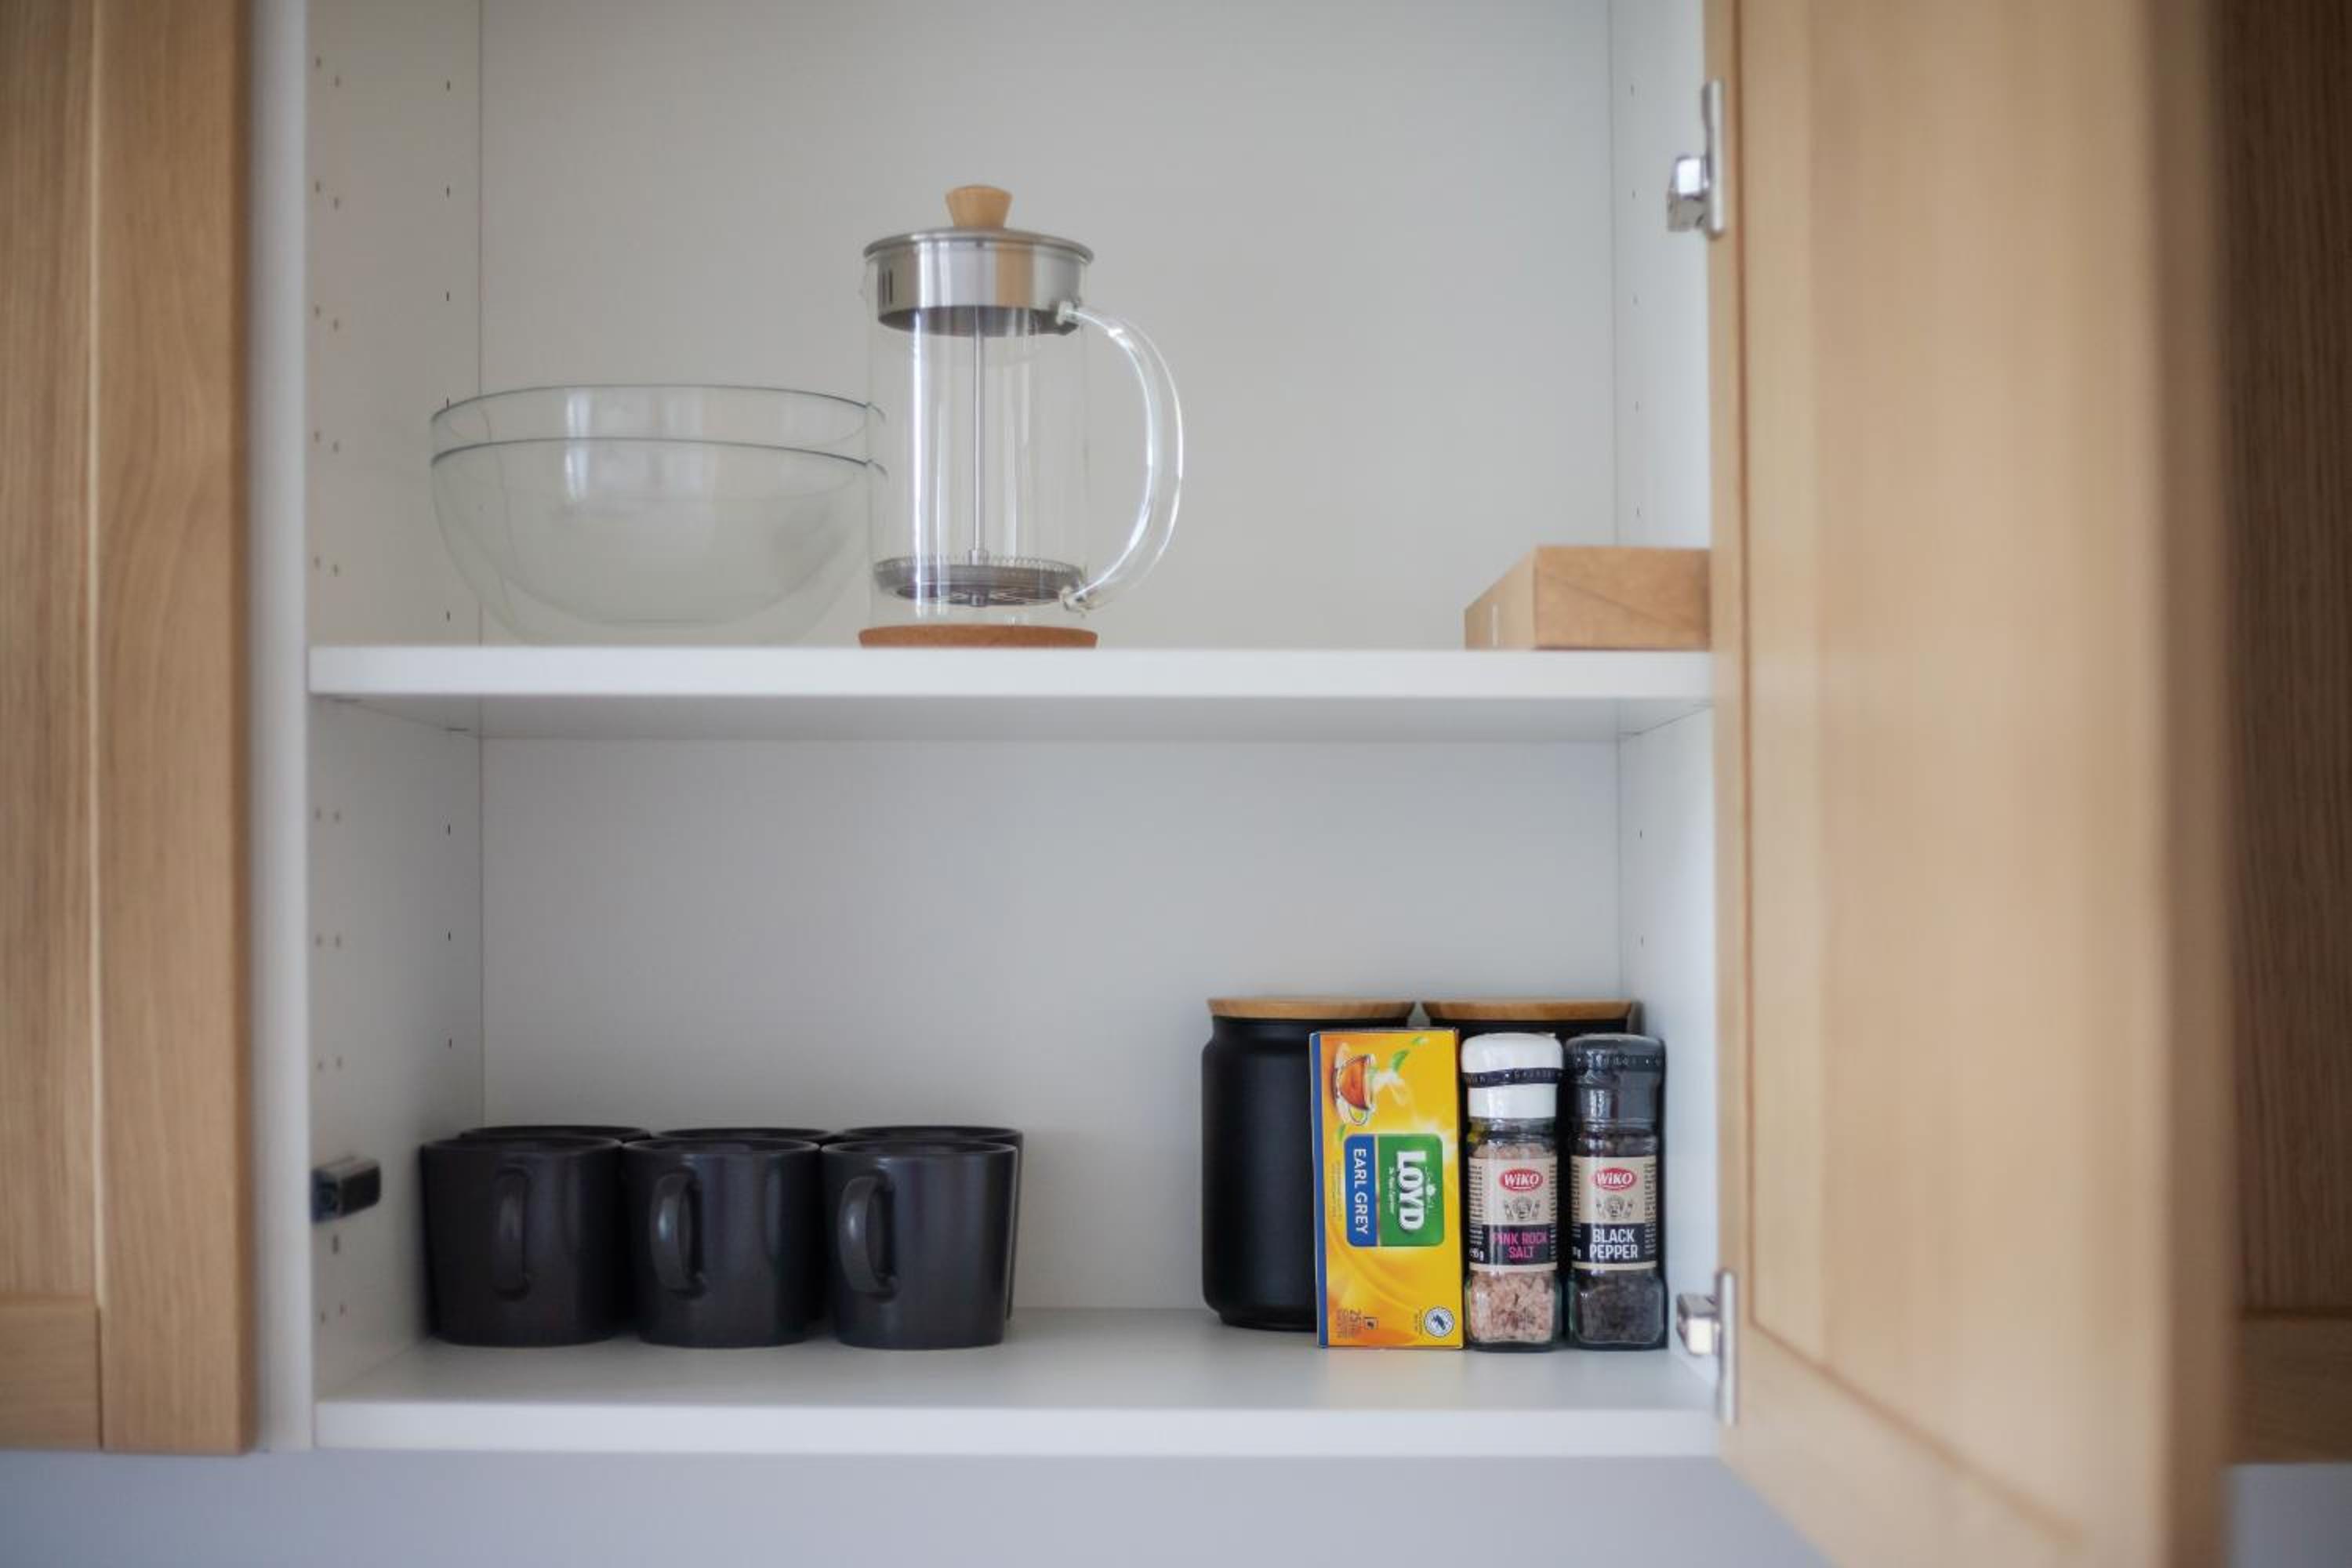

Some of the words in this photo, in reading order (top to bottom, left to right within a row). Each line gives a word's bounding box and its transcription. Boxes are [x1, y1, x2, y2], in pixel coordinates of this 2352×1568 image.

[1353, 1149, 1367, 1189] EARL
[1397, 1151, 1426, 1230] LOYD
[1354, 1192, 1368, 1235] GREY
[1522, 1232, 1548, 1243] ROCK
[1592, 1229, 1635, 1243] BLACK
[1508, 1245, 1534, 1258] SALT
[1589, 1243, 1638, 1258] PEPPER
